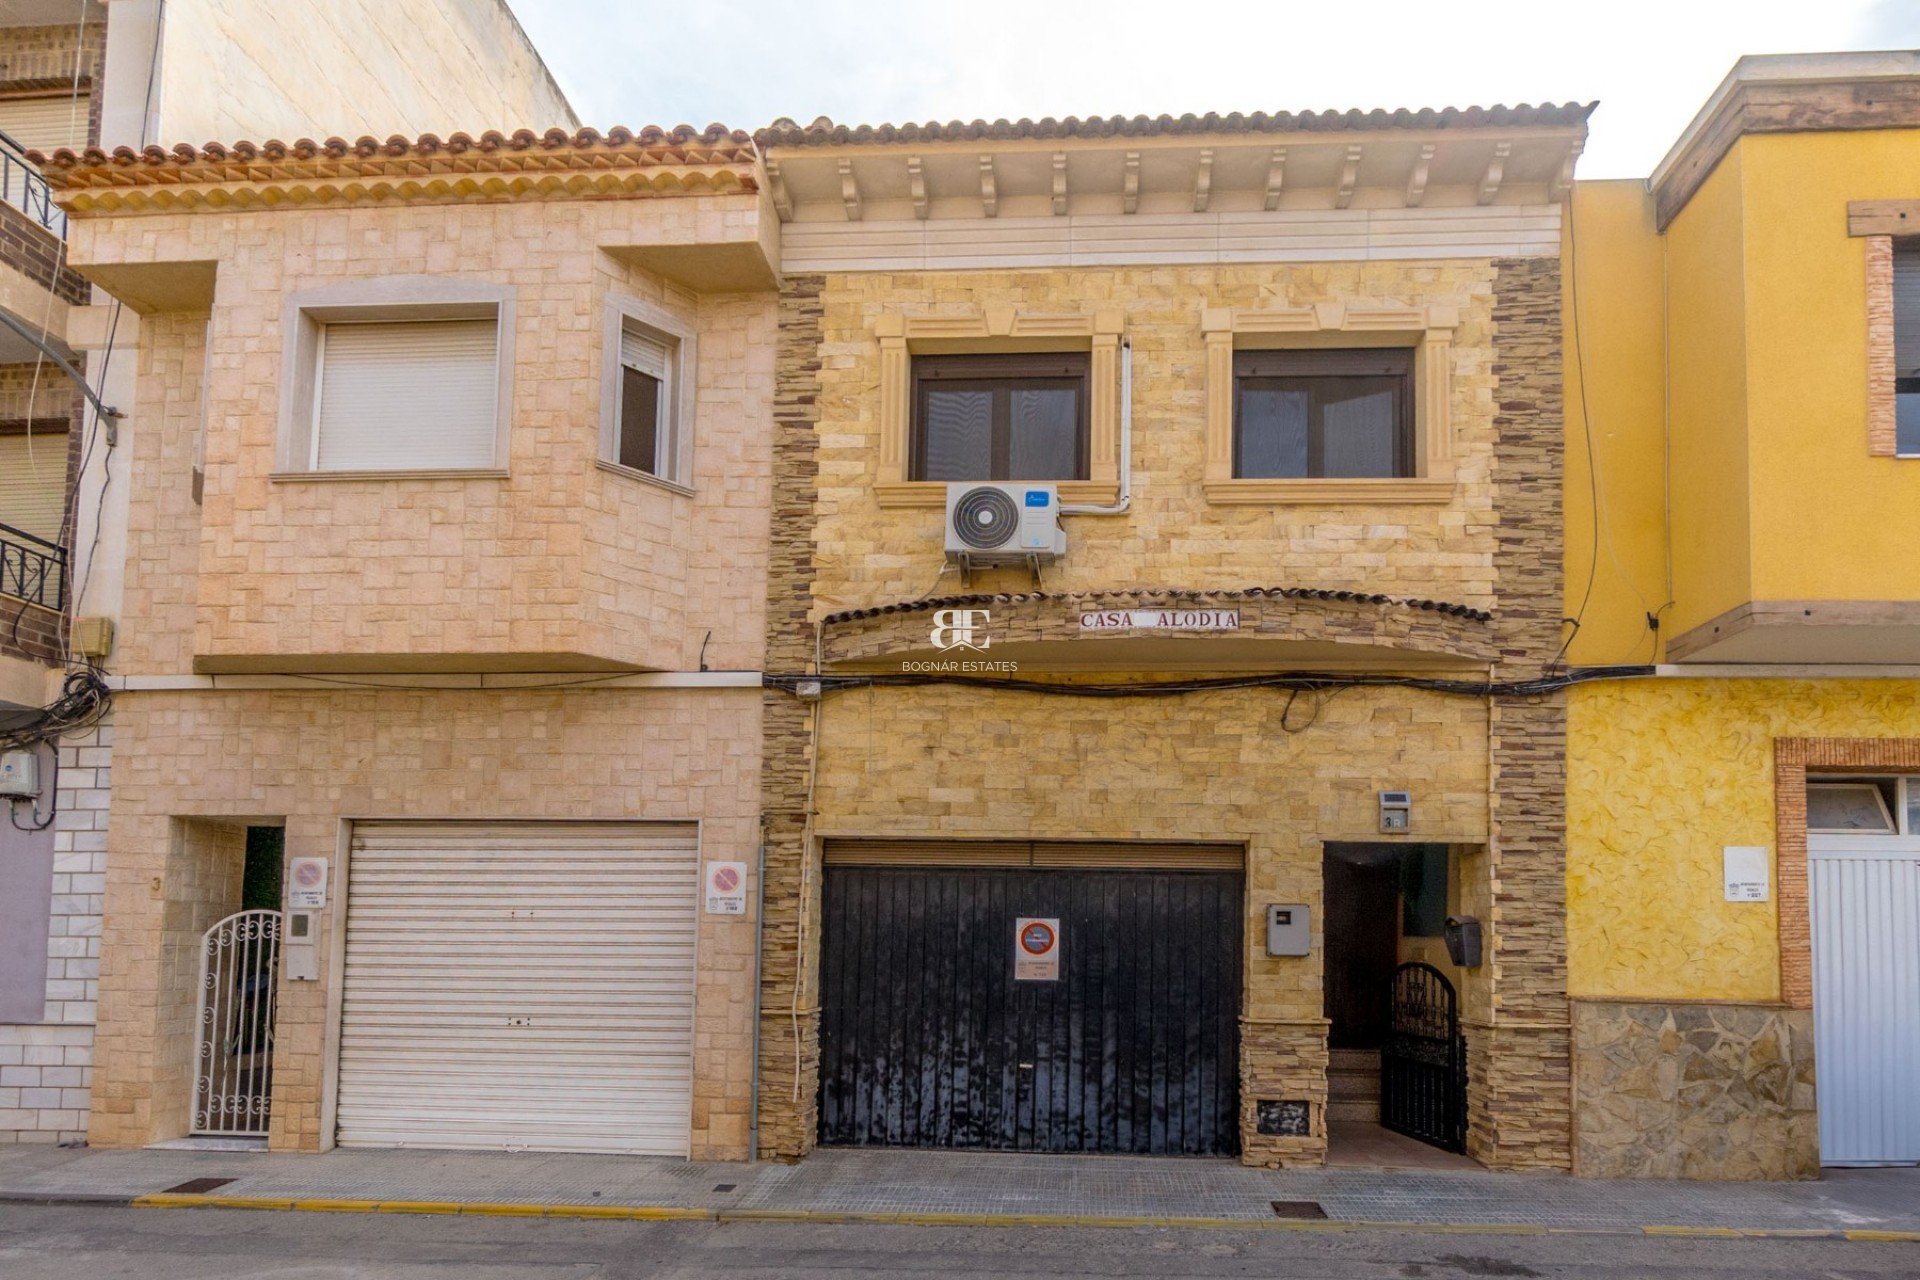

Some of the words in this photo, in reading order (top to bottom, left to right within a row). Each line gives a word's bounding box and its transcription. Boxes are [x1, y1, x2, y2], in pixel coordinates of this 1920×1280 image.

[1080, 612, 1133, 628] CASA
[1157, 612, 1239, 628] ALODIA
[152, 876, 161, 891] 3
